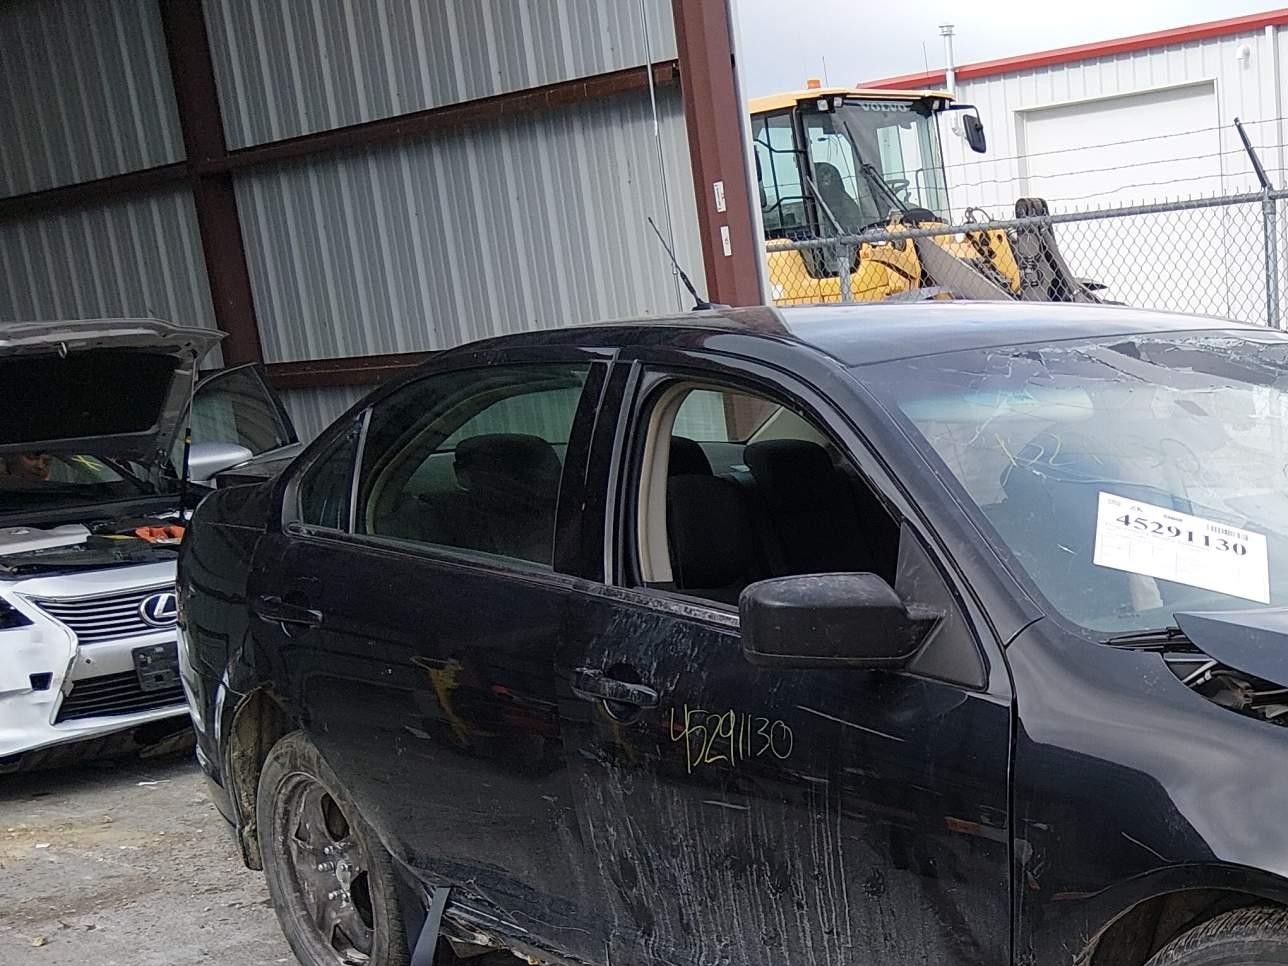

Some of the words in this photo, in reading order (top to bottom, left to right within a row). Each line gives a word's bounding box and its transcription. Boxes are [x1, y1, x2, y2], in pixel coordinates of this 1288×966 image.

[862, 102, 906, 112] VOLVO
[1116, 514, 1247, 556] 45291130
[670, 703, 793, 774] 45291130
